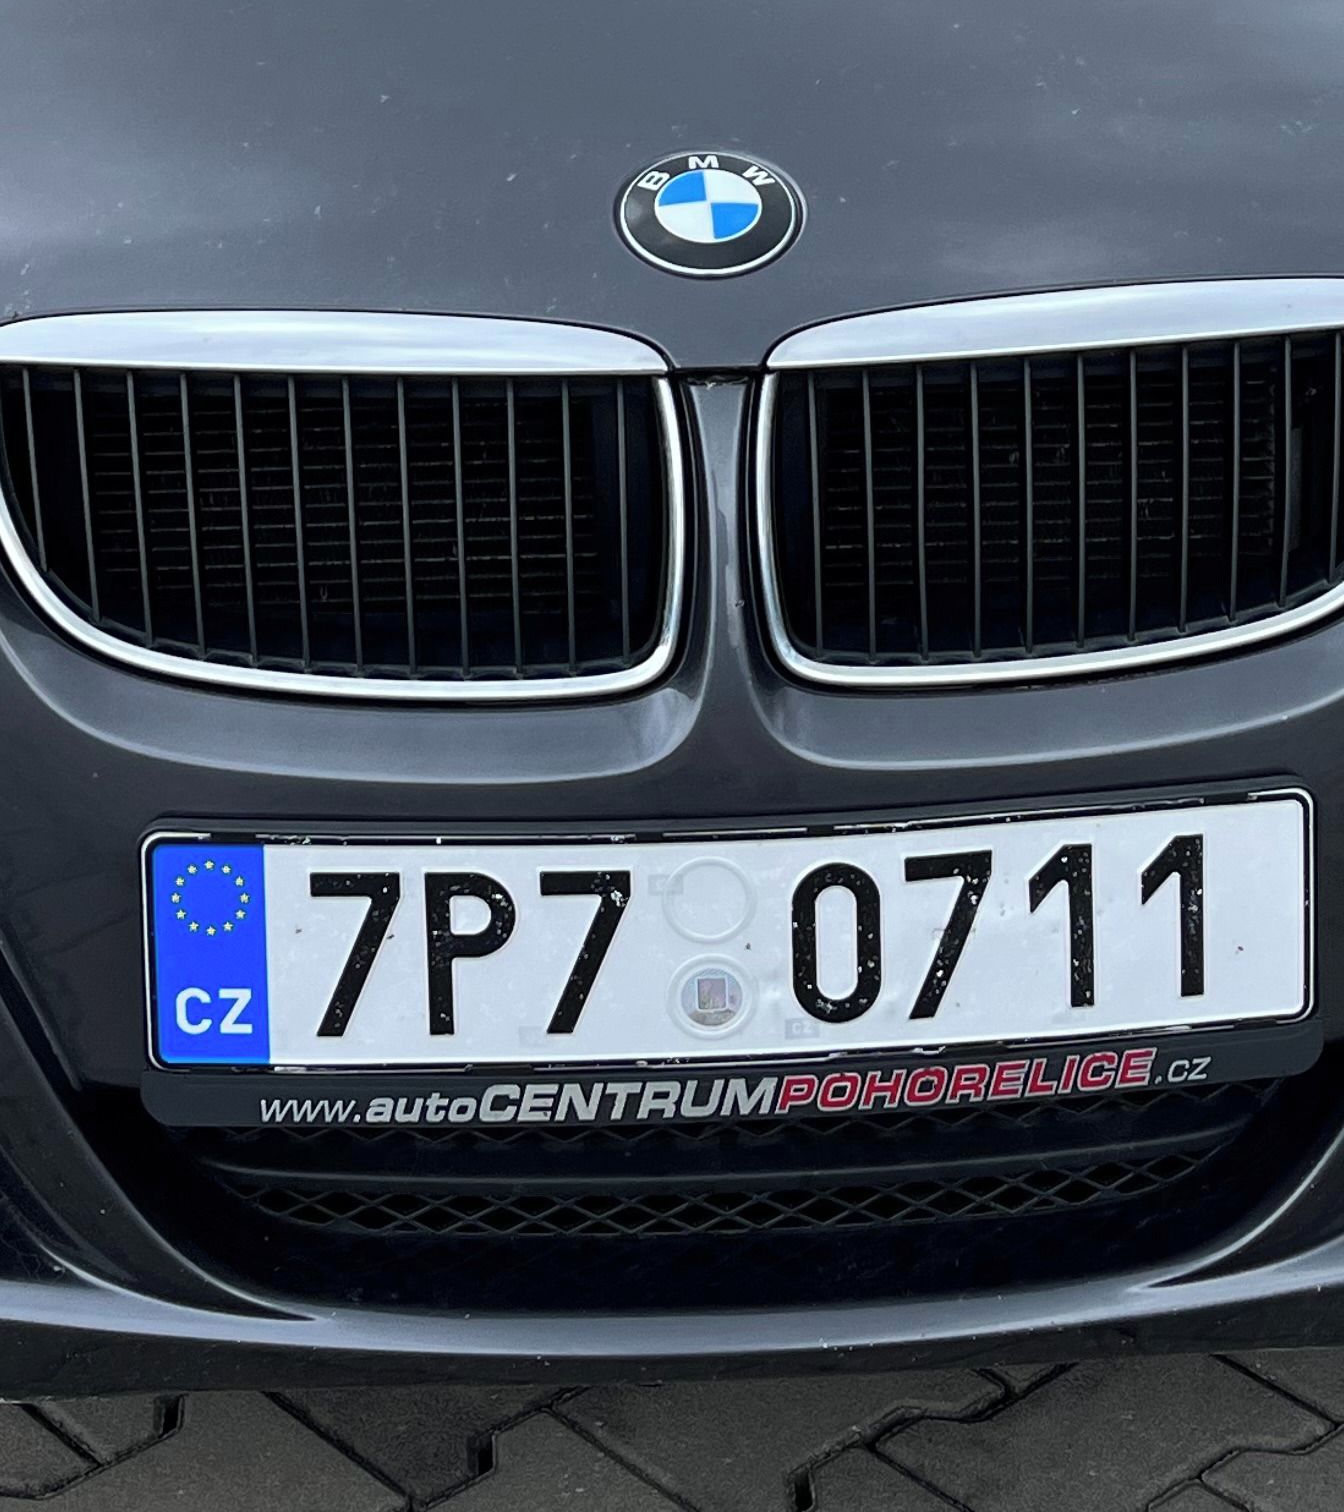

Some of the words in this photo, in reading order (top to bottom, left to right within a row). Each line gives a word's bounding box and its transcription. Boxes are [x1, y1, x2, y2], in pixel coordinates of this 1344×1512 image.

[637, 154, 776, 192] BMW
[309, 870, 632, 1038] 7P7
[791, 833, 1205, 1024] 0711
[175, 987, 254, 1035] CZ
